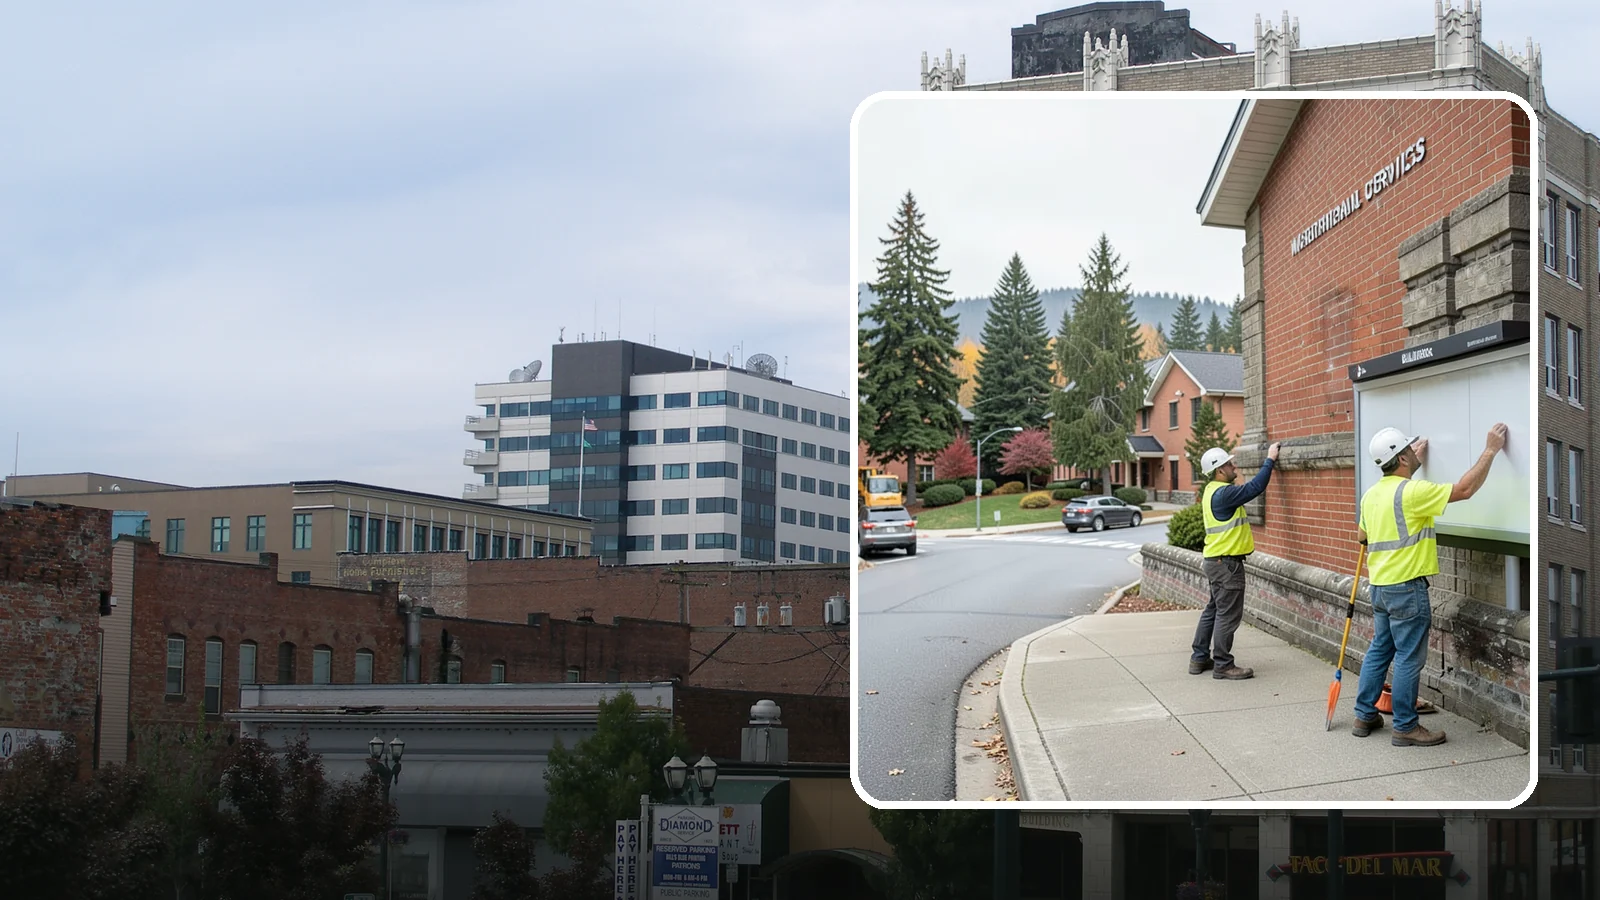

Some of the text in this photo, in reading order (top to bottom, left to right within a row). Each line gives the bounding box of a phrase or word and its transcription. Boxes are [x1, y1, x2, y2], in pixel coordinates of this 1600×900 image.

[370, 566, 427, 577] Furnishers
[660, 818, 713, 833] DIAMOND
[1022, 815, 1070, 828] BUILDING
[656, 845, 716, 854] RESERVED PARKING
[616, 825, 625, 893] PAY HERE
[627, 824, 637, 893] PAY HERE
[1289, 855, 1443, 876] TAC DEL MAR
[660, 888, 710, 898] PUBLIC PARKING
